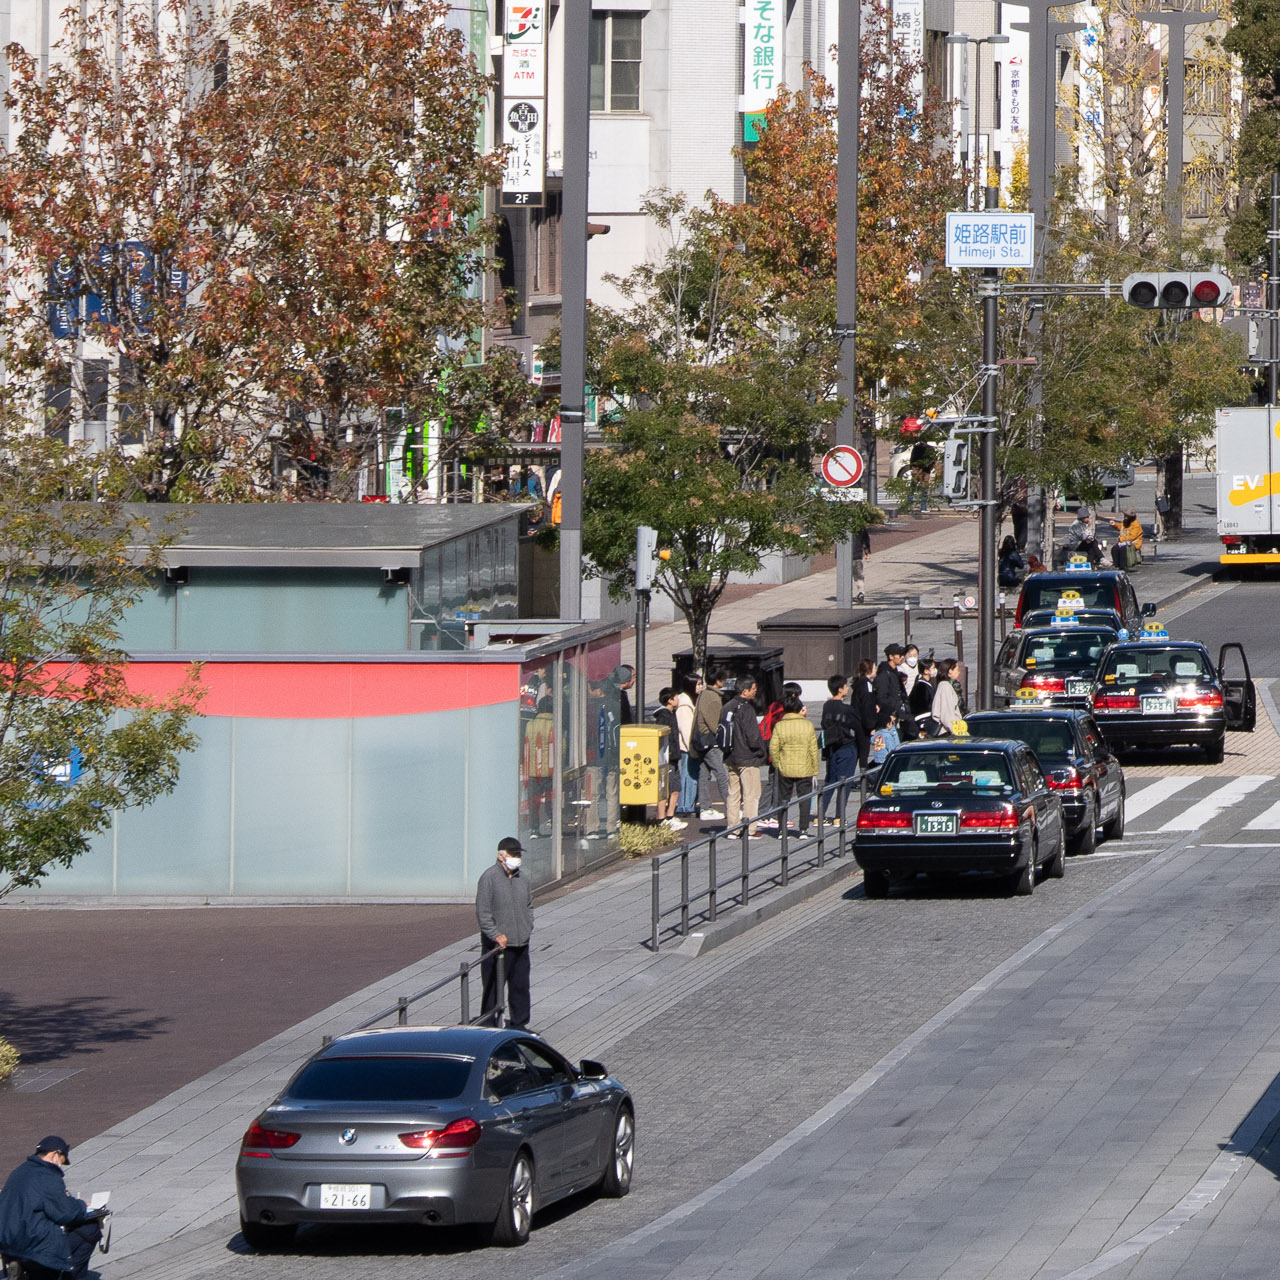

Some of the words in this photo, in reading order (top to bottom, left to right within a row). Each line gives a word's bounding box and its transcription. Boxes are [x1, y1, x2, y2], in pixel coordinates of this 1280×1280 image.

[513, 48, 538, 57] たばこ
[514, 71, 536, 80] ATM
[516, 193, 530, 203] 2F
[953, 223, 1027, 245] 姫路駅前
[958, 246, 996, 259] Himeji
[1000, 247, 1025, 257] Sta.
[1233, 475, 1261, 491] EV
[927, 822, 953, 832] 13-13
[331, 1194, 367, 1207] 21-66
